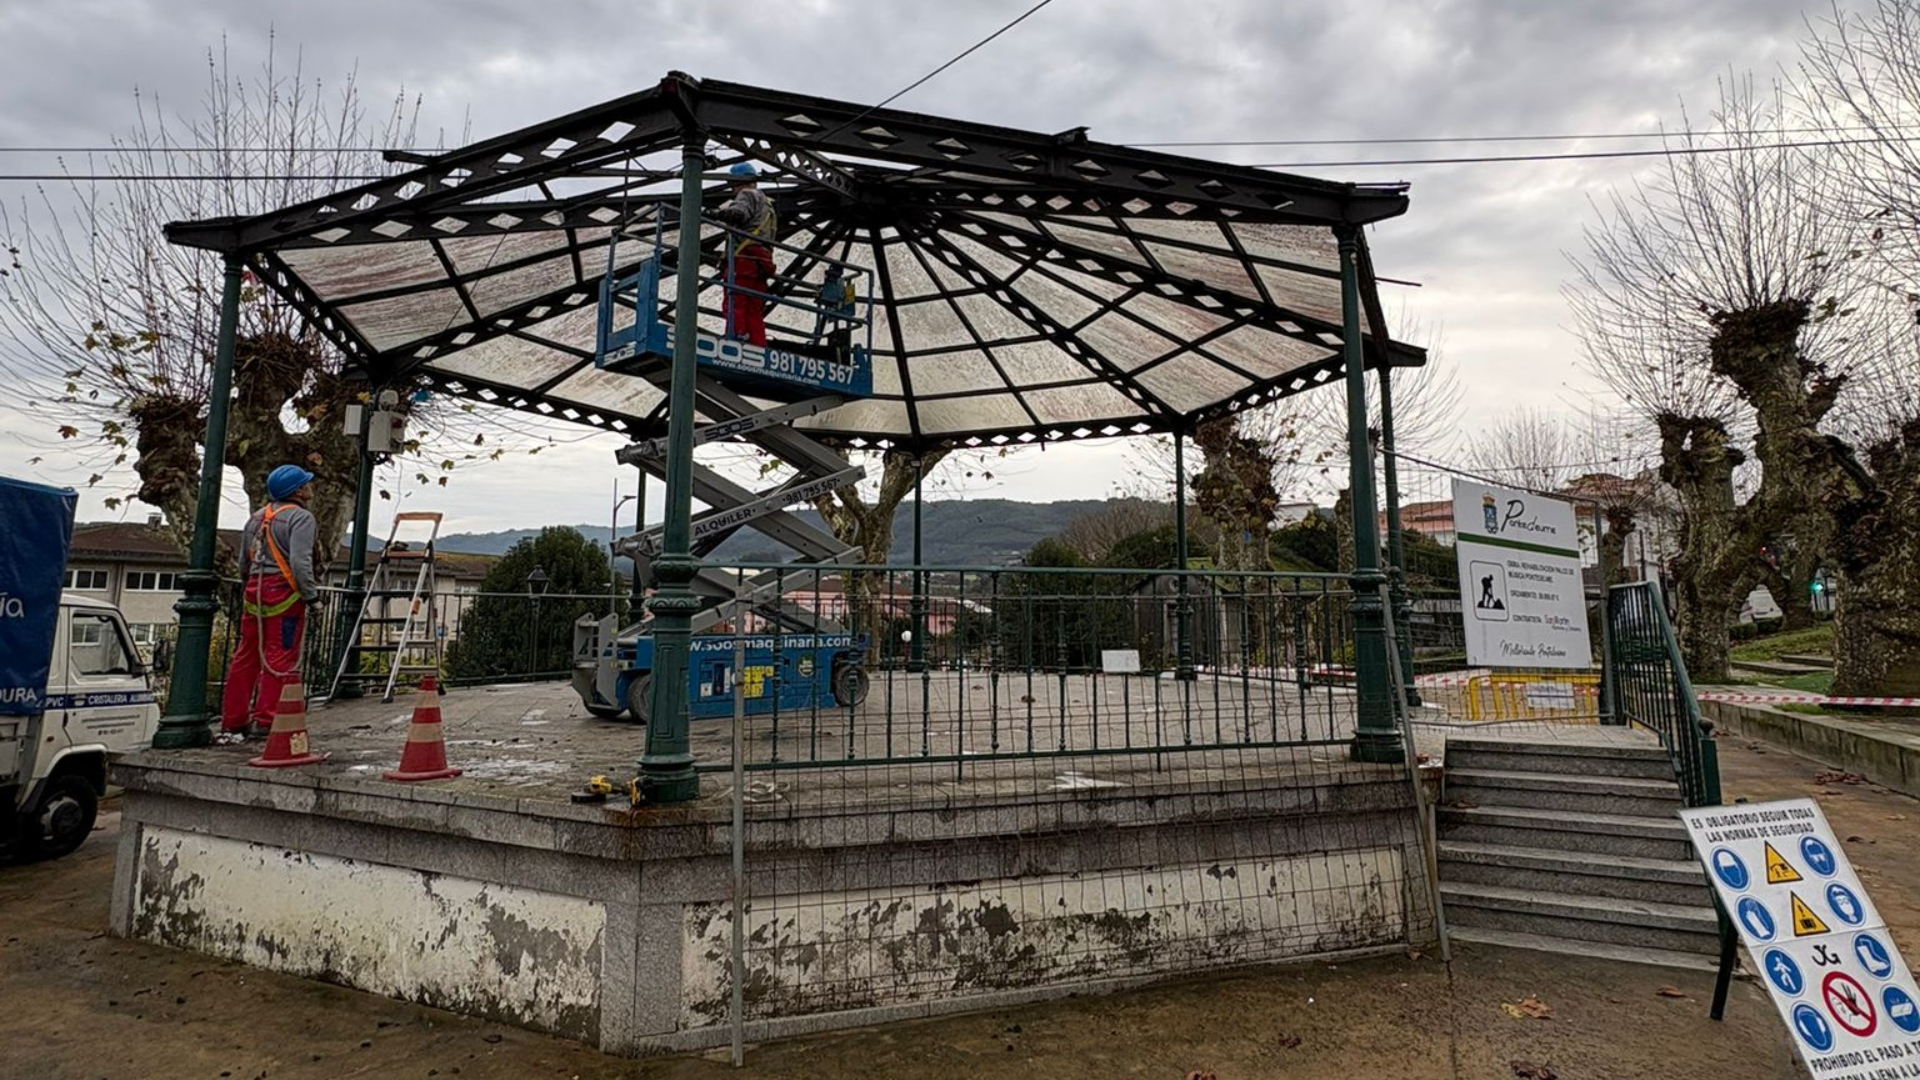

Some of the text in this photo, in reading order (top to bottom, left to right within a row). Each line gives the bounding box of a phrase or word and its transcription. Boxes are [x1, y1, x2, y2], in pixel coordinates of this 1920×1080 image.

[769, 350, 795, 373] 981
[799, 356, 825, 380] 795
[828, 362, 854, 385] 567
[694, 509, 752, 536] ALQUILER
[0, 687, 38, 703] URA
[45, 696, 65, 707] PVC
[1691, 807, 1815, 829] ES OBLIGATORIO SEGUIR TODAS
[1705, 822, 1815, 843] LAS NORMAS DE SEGURIDAD
[1811, 1051, 1864, 1072] PROHIBIDO
[1863, 1049, 1879, 1063] EL
[1877, 1044, 1904, 1060] PASO
[1903, 1043, 1913, 1056] A
